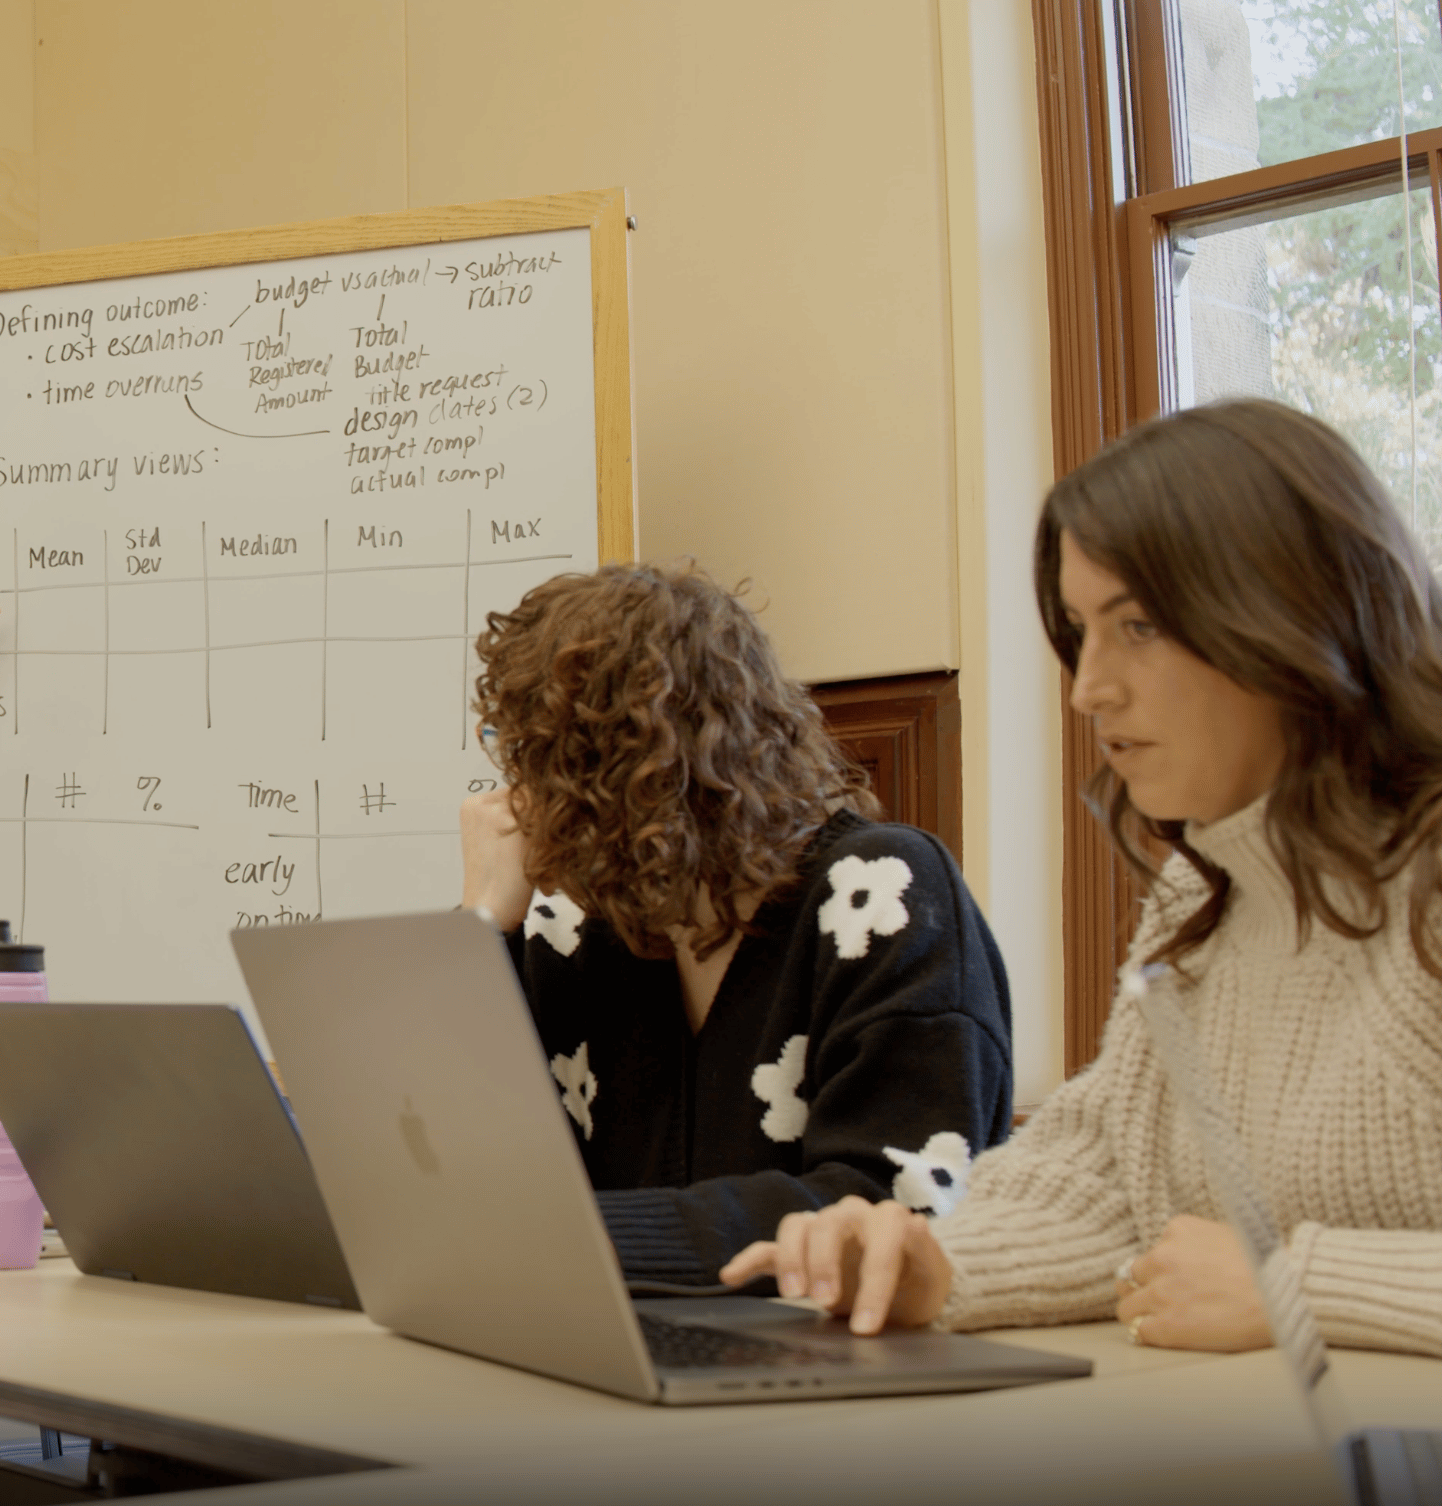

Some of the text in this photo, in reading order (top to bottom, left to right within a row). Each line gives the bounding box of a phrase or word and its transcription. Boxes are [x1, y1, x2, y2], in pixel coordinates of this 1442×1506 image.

[255, 270, 333, 309] budget
[107, 291, 208, 322] outcome:
[45, 325, 224, 364] cost escalation
[349, 320, 407, 349] Total
[355, 344, 430, 384] Budget
[42, 370, 203, 404] time overruns
[254, 381, 333, 414] Amount
[419, 363, 509, 400] request
[344, 406, 418, 439] design
[134, 446, 219, 476] views:
[125, 526, 162, 550] Std
[220, 534, 298, 556] Median
[357, 525, 403, 548] Min
[491, 518, 542, 544] Max
[29, 546, 84, 569] Mean
[126, 556, 162, 576] Dev
[55, 771, 87, 809] #
[137, 776, 162, 812] %
[359, 781, 397, 816] #
[224, 855, 295, 896] early
